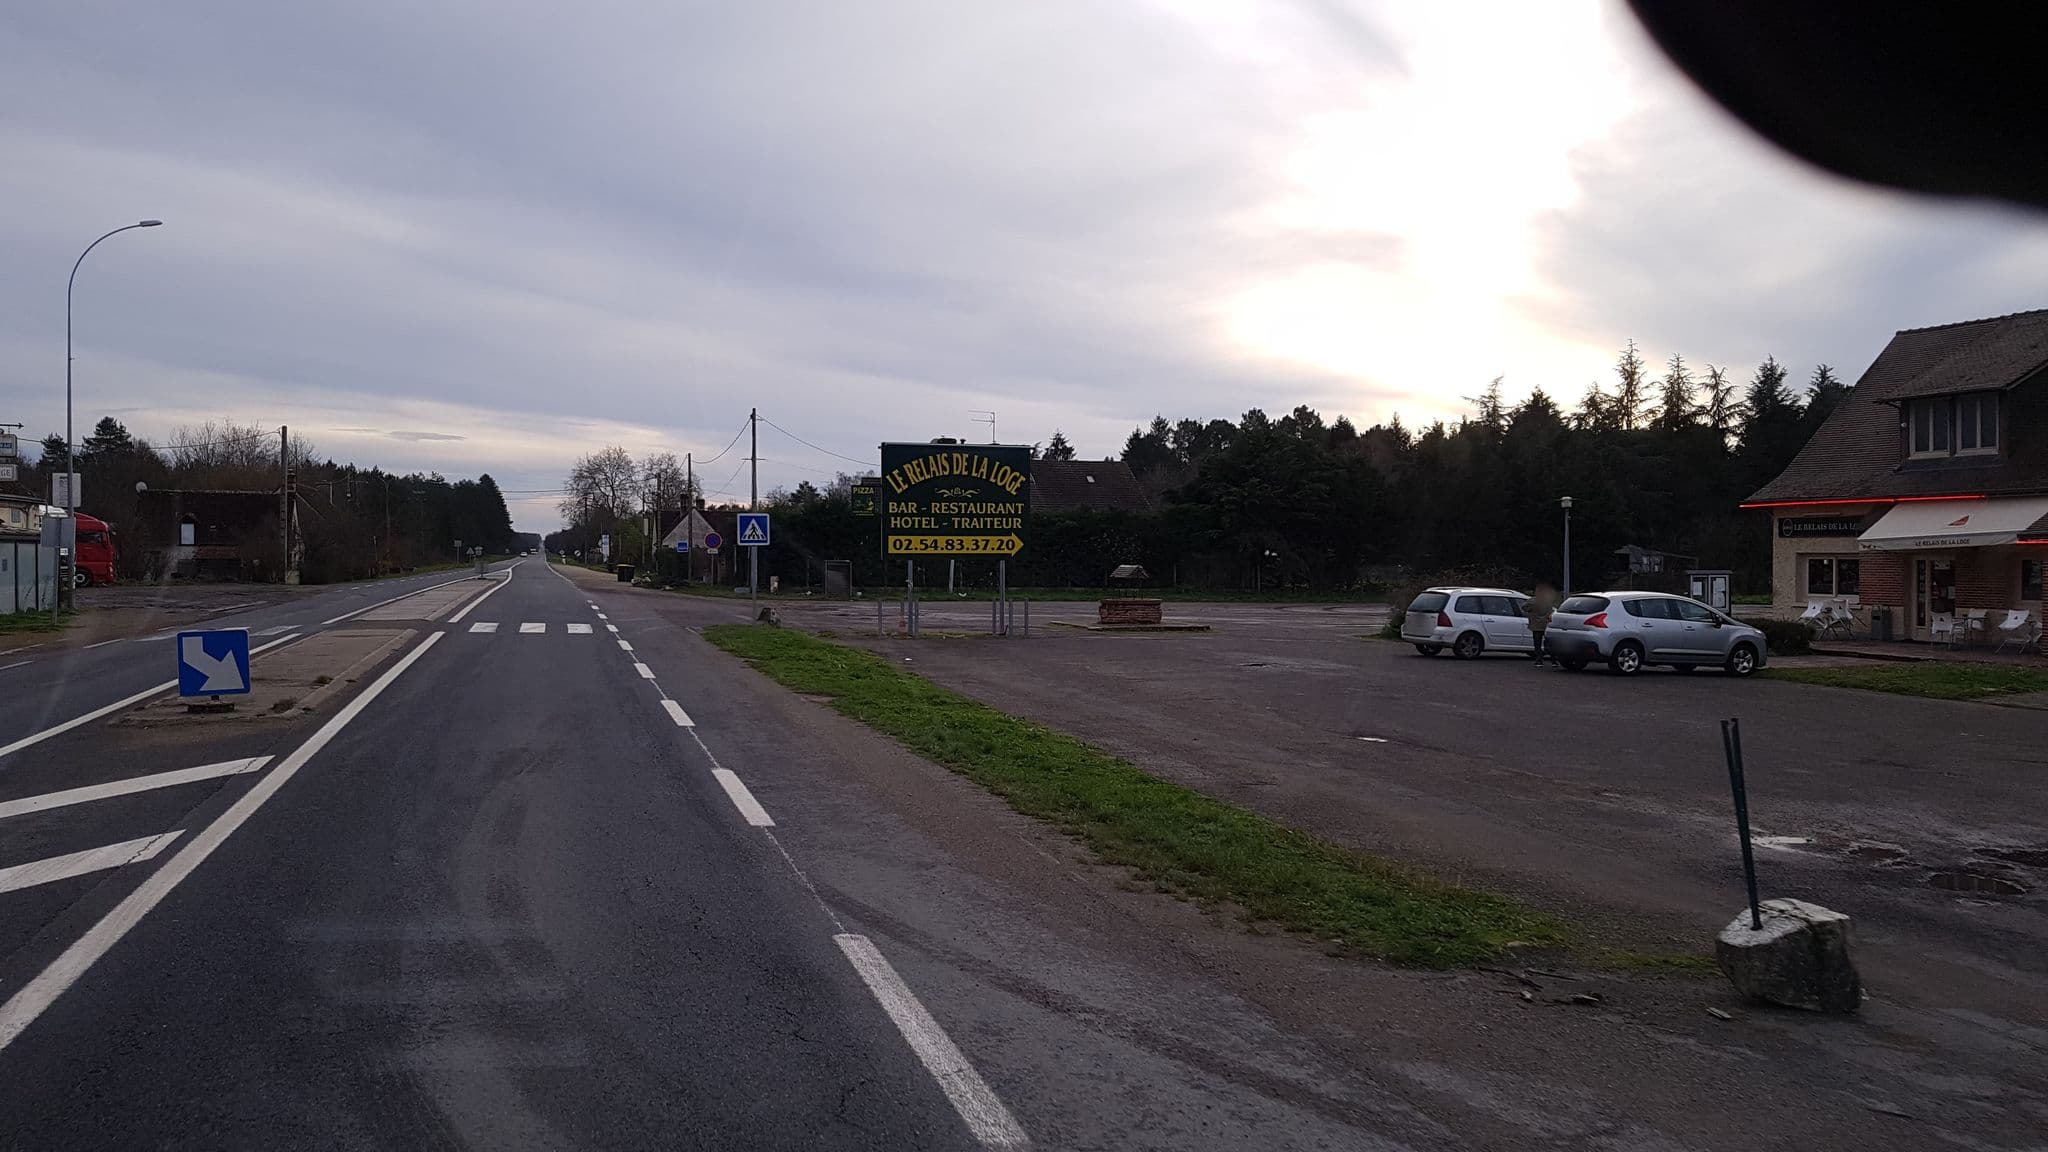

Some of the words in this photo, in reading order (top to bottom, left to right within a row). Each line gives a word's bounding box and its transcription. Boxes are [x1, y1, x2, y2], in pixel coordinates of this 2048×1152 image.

[885, 469, 909, 494] LE
[902, 452, 951, 485] RELAIS
[952, 452, 969, 476] DE
[971, 454, 988, 479] LA
[989, 461, 1026, 496] LOGE
[853, 486, 875, 494] PIZZA
[888, 502, 918, 514] BAR
[931, 502, 1024, 515] RESTAURANT
[890, 516, 939, 528] HOTEL
[951, 517, 1022, 529] TRAITEUR
[1793, 523, 1803, 531] LE
[1803, 523, 1828, 531] RELAIS
[1828, 522, 1838, 530] DE
[1838, 522, 1848, 530] LA
[892, 538, 1016, 551] 02.54.83.37.20
